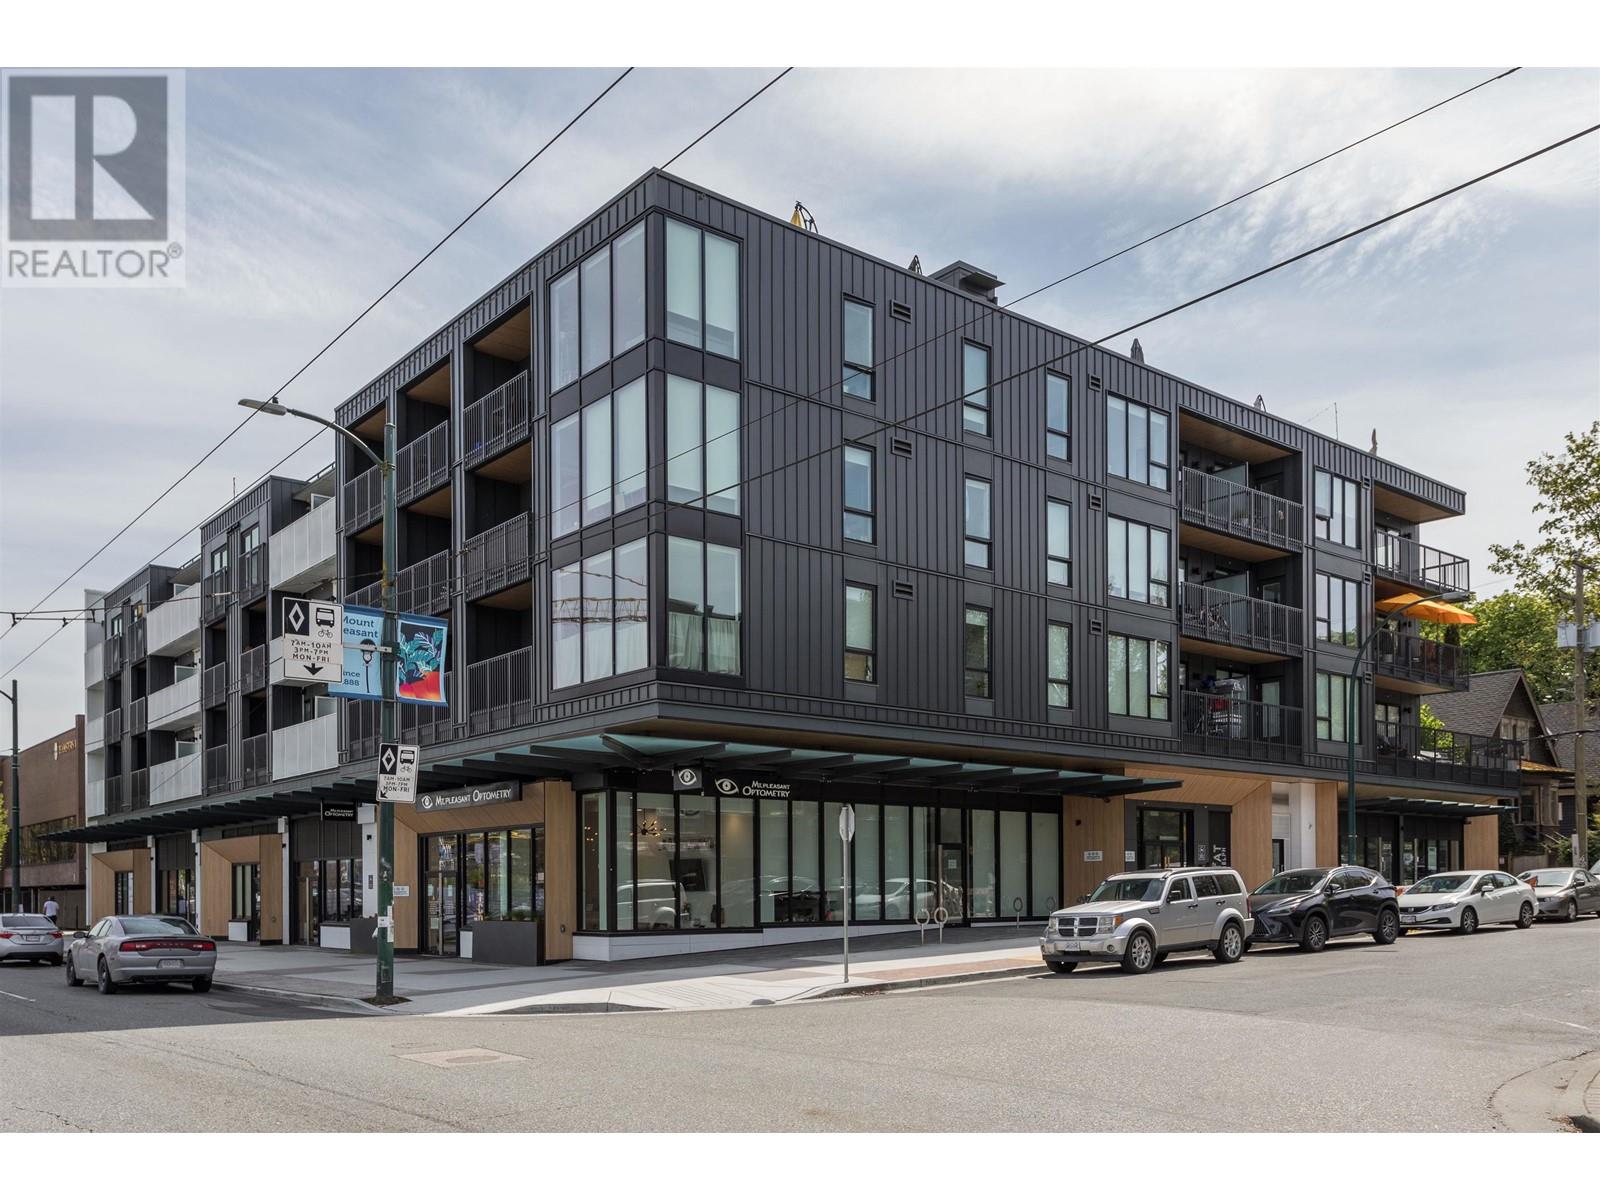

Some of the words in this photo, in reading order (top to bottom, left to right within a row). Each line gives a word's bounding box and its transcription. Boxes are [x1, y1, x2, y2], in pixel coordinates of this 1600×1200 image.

[343, 615, 375, 628] Mount
[343, 627, 379, 638] easant
[292, 653, 330, 663] MON-FRI
[742, 785, 791, 798] OPTOMETRY
